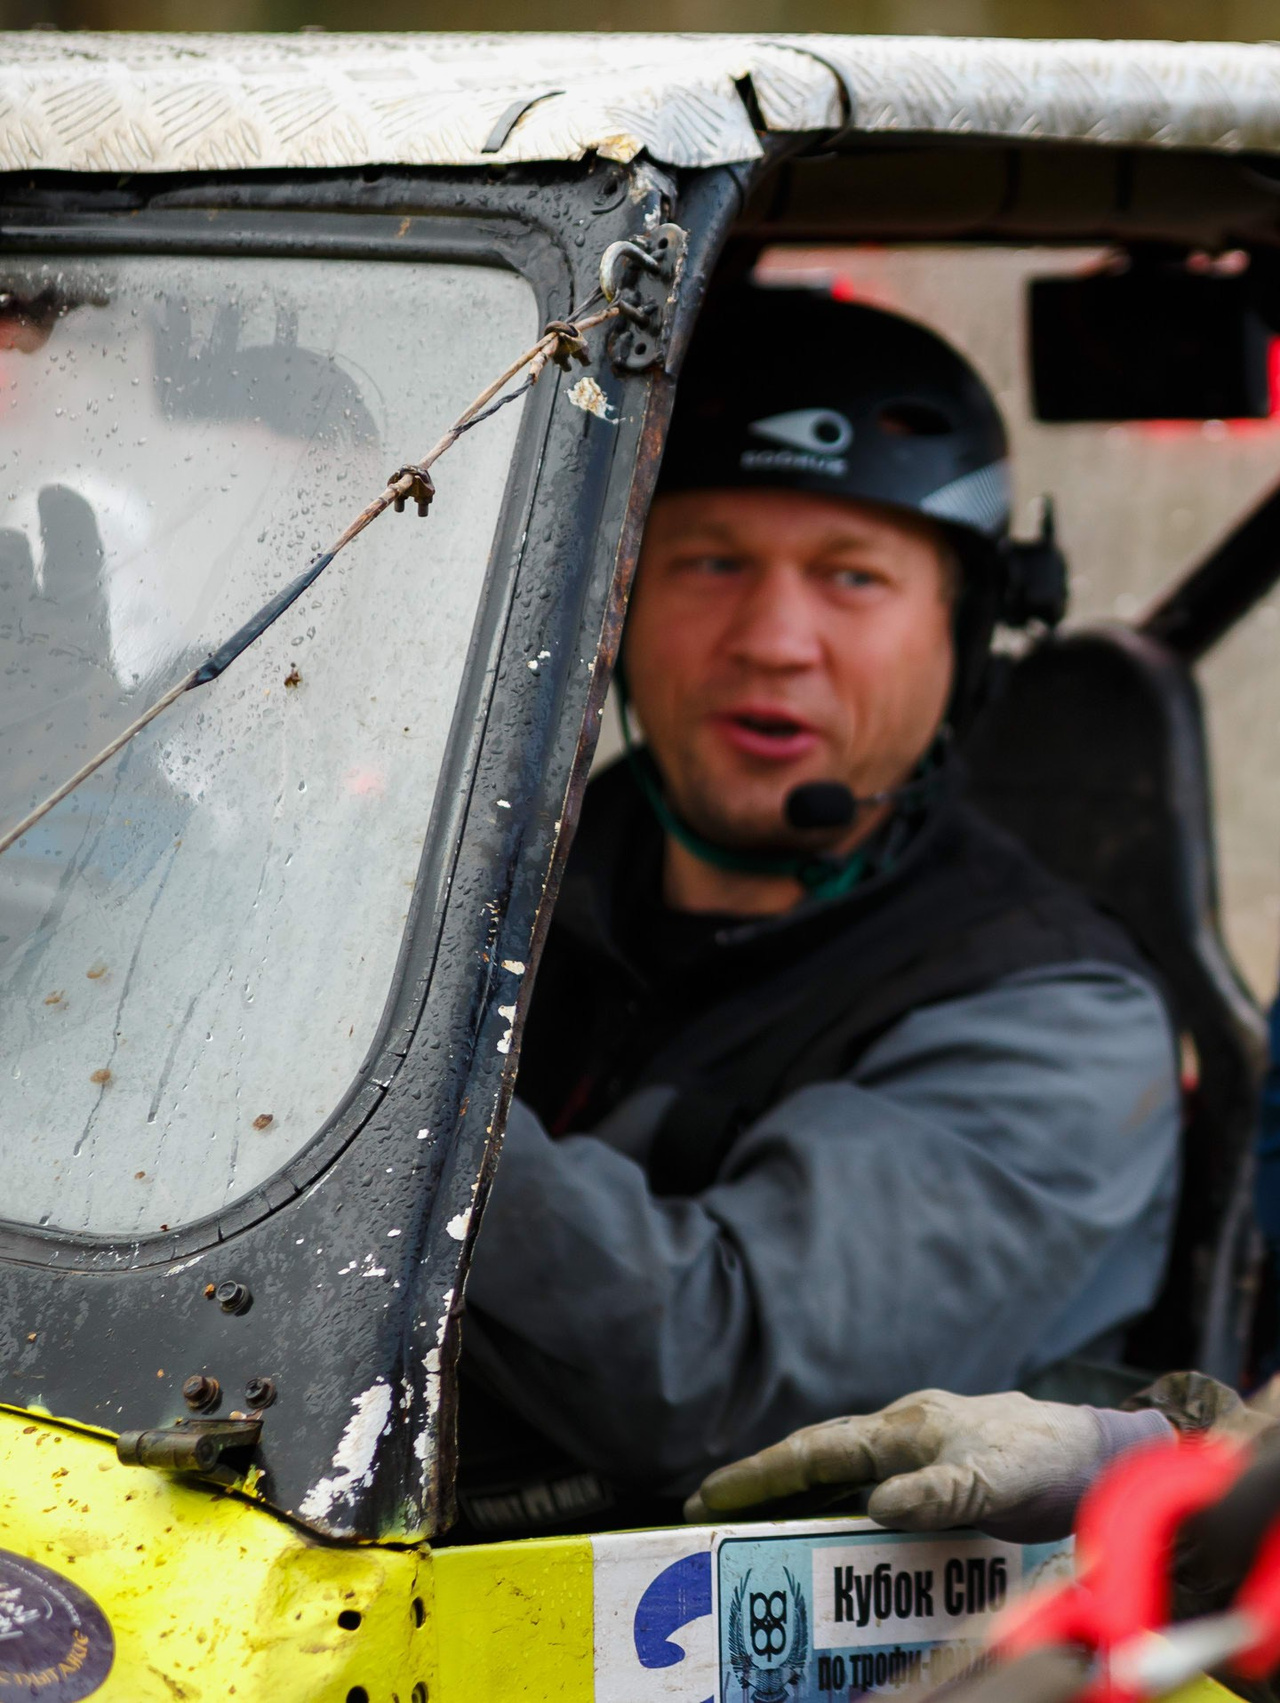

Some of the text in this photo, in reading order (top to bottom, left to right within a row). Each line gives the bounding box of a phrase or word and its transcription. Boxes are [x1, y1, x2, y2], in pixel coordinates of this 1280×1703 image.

[834, 1557, 1008, 1627] Кубок СПб
[818, 1655, 846, 1692] по
